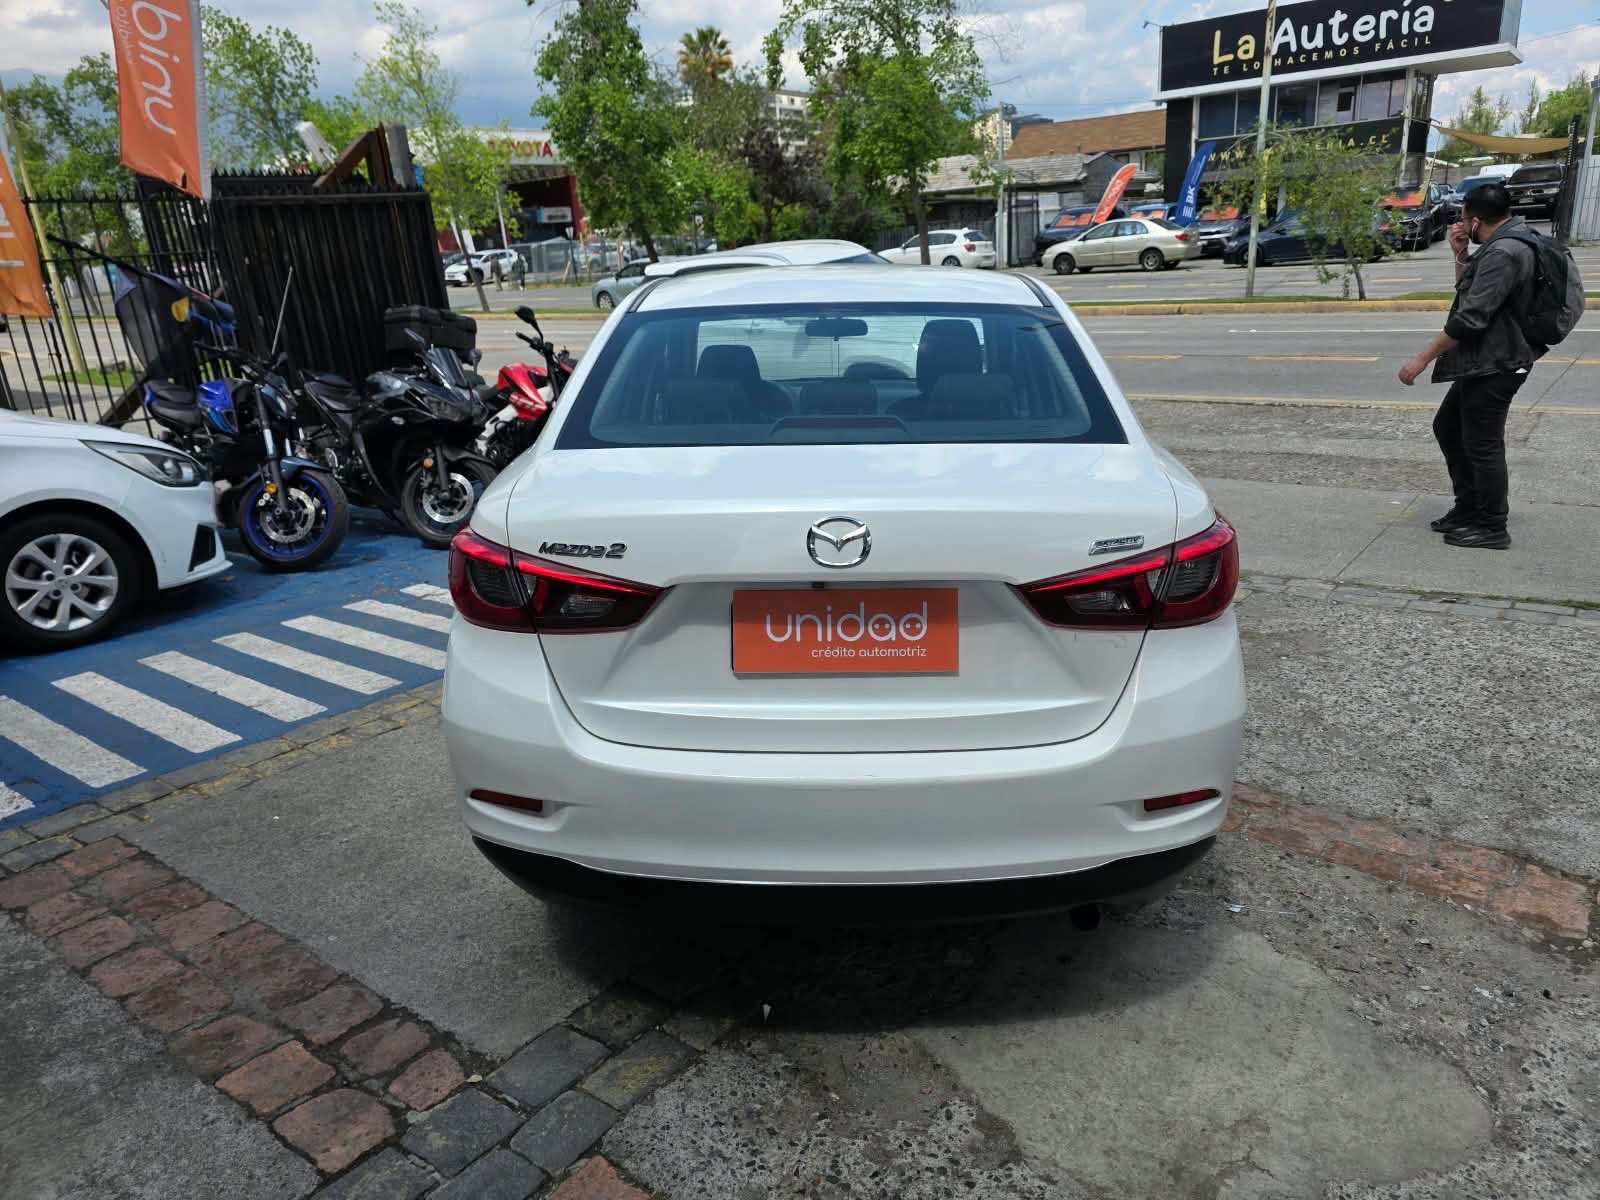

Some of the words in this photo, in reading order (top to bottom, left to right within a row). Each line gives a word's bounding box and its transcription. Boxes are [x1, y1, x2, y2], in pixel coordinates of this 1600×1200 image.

[1213, 30, 1256, 65] La
[1271, 0, 1435, 55] Autería
[1213, 66, 1231, 76] TE
[1243, 61, 1261, 72] LO
[1274, 46, 1360, 67] HACEMOS
[1375, 36, 1431, 52] FÁCIL
[765, 601, 928, 642] unidad
[811, 646, 856, 658] crédito
[858, 646, 927, 657] automotriz
